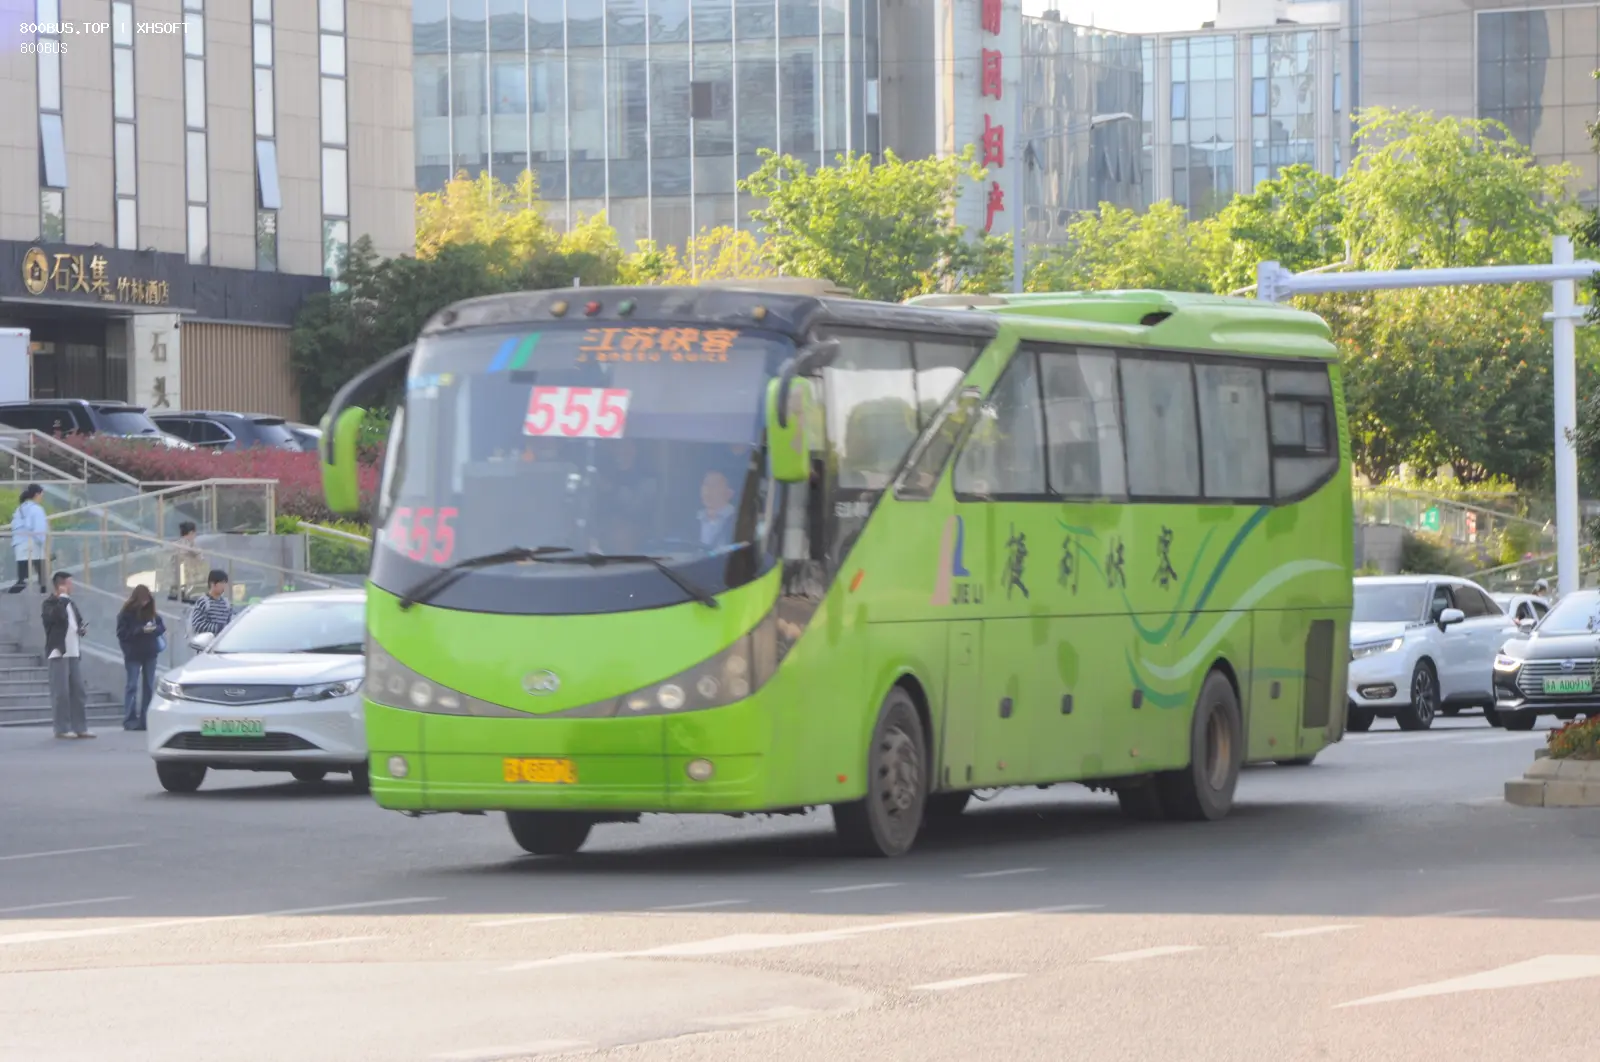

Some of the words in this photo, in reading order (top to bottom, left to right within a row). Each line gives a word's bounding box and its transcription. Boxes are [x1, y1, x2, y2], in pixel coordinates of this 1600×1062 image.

[50, 253, 110, 294] 石头集
[524, 386, 629, 437] 555
[389, 506, 459, 564] 555
